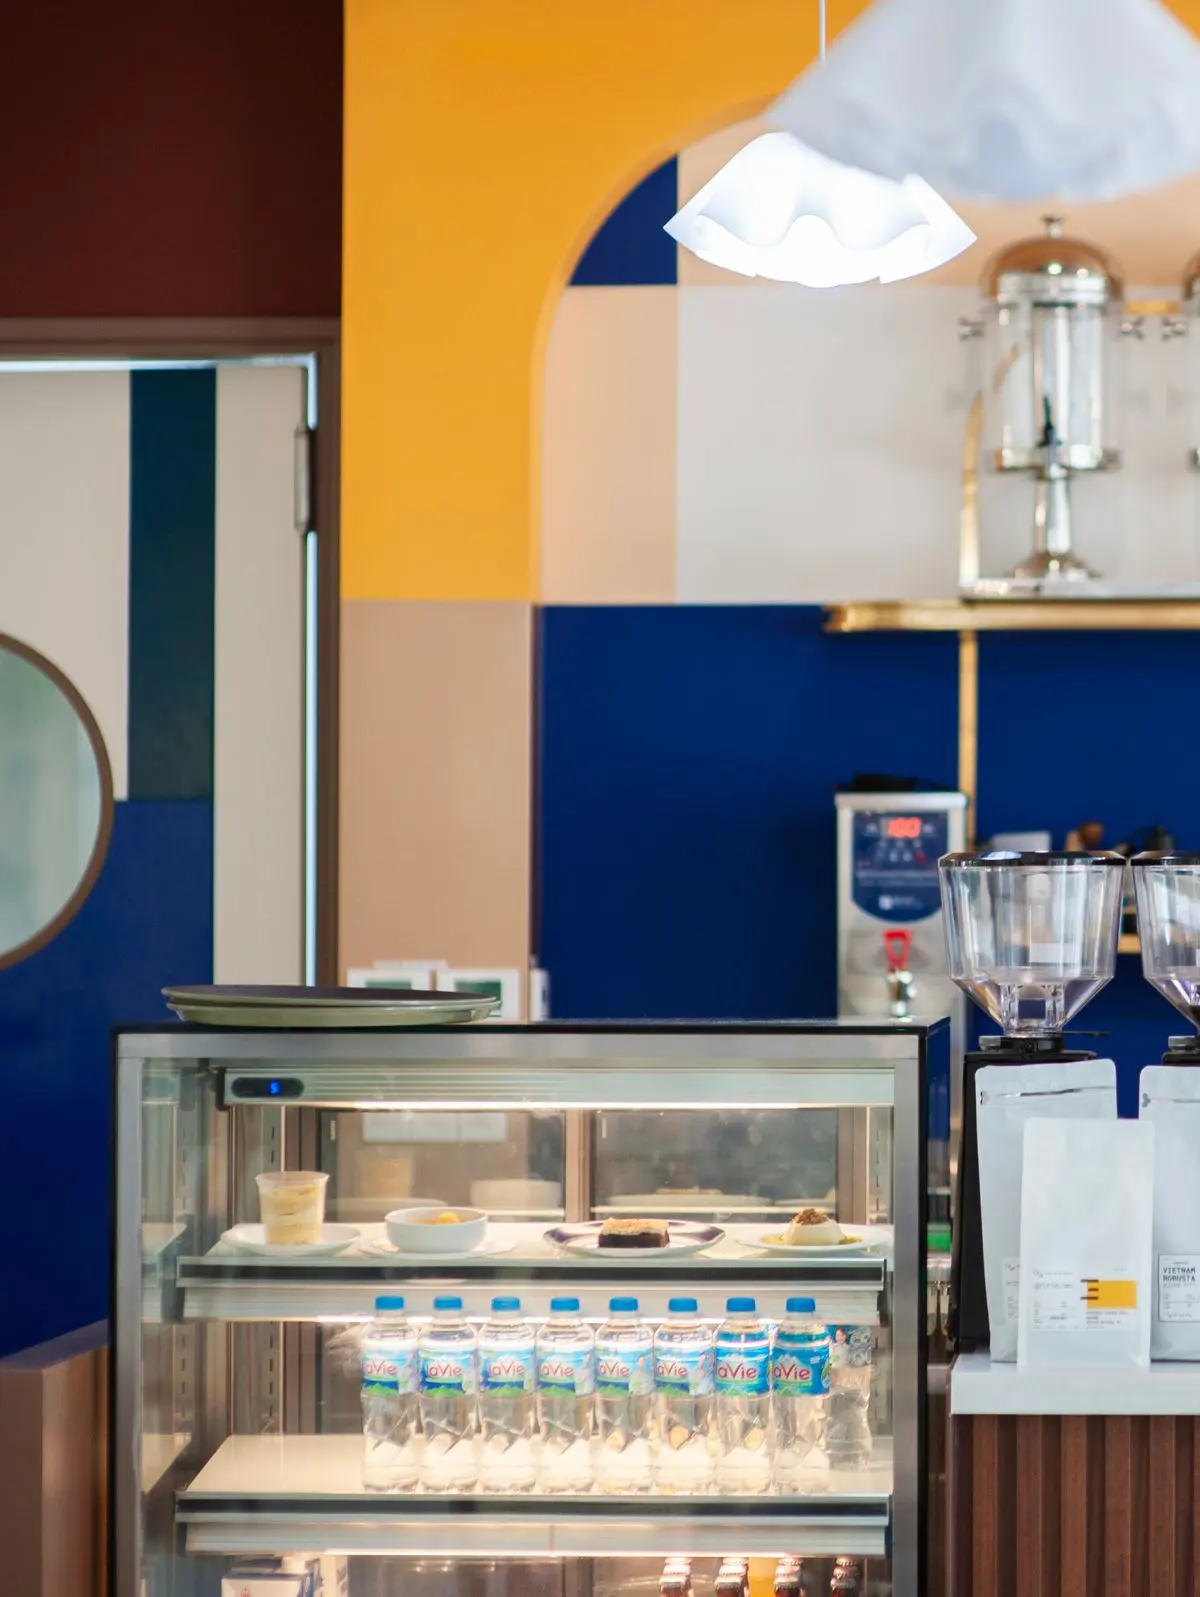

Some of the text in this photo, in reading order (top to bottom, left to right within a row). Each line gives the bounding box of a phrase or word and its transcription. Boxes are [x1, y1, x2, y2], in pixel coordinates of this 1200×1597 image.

[1163, 1266, 1196, 1275] VIETNAM
[599, 1361, 630, 1378] aVie
[656, 1361, 689, 1377] aVie
[774, 1363, 811, 1381] aVie
